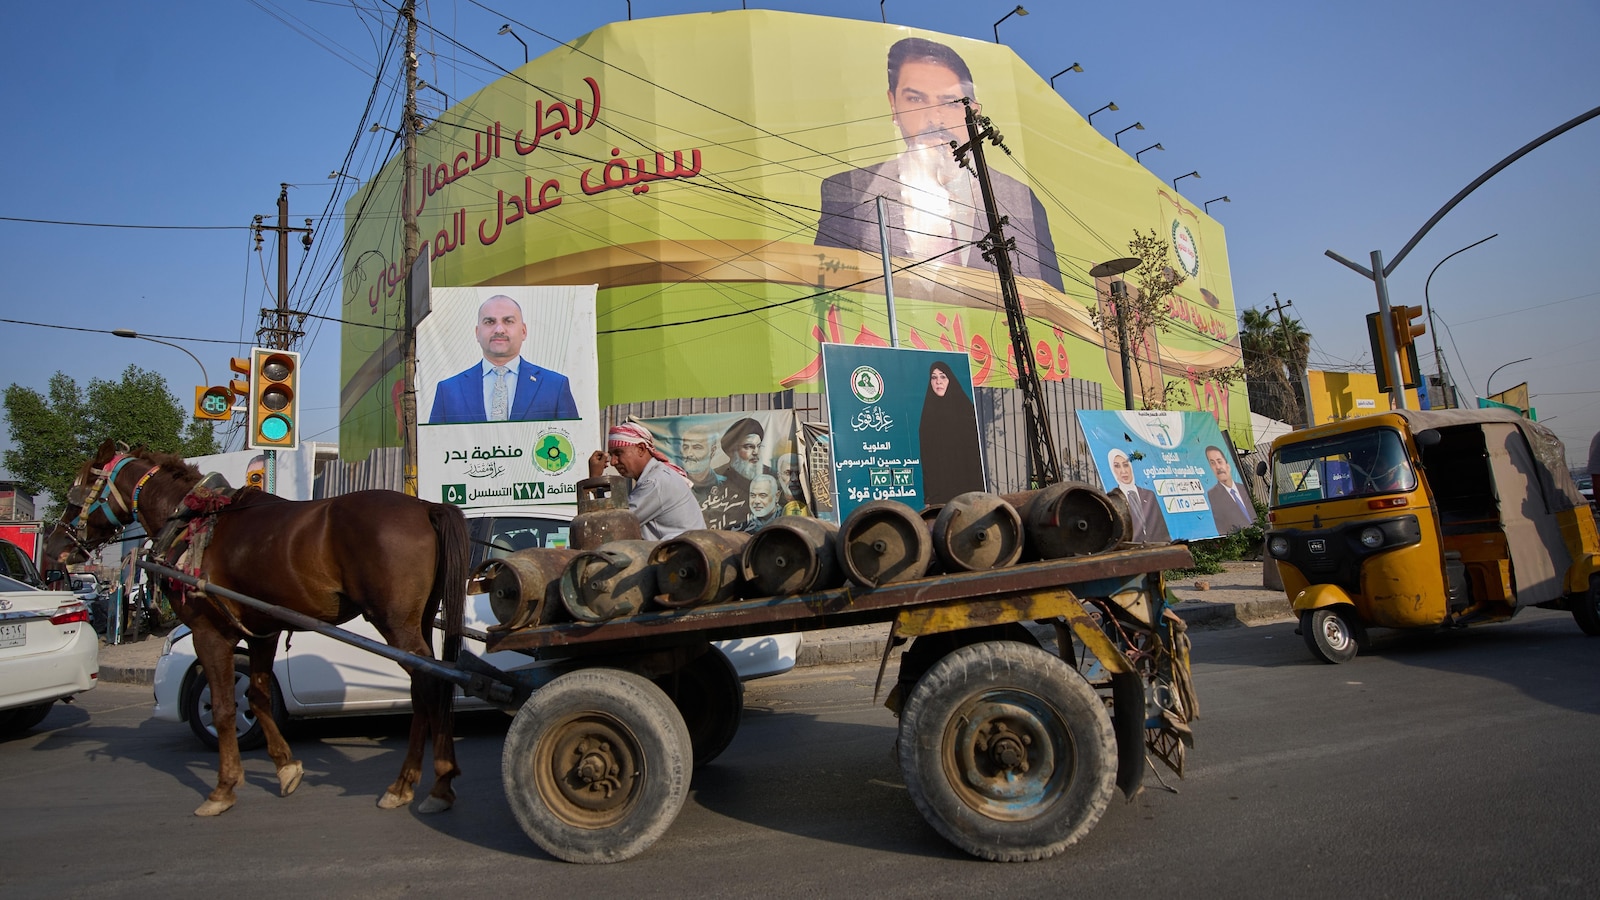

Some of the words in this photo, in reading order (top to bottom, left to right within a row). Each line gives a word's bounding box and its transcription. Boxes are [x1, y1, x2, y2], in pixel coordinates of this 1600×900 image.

[580, 147, 702, 195] سيف
[478, 176, 563, 245] عادل
[471, 446, 523, 460] منظمة
[862, 441, 891, 451] العلوية
[444, 450, 468, 464] بدر
[835, 456, 875, 471] المرسومي
[877, 457, 901, 467] حسين
[903, 457, 919, 466] سحر
[873, 475, 887, 485] ٨٥
[468, 487, 512, 500] التسلسل
[514, 482, 544, 500] ٢١٨
[547, 483, 577, 494] لقائمة
[873, 485, 917, 501] صادقون
